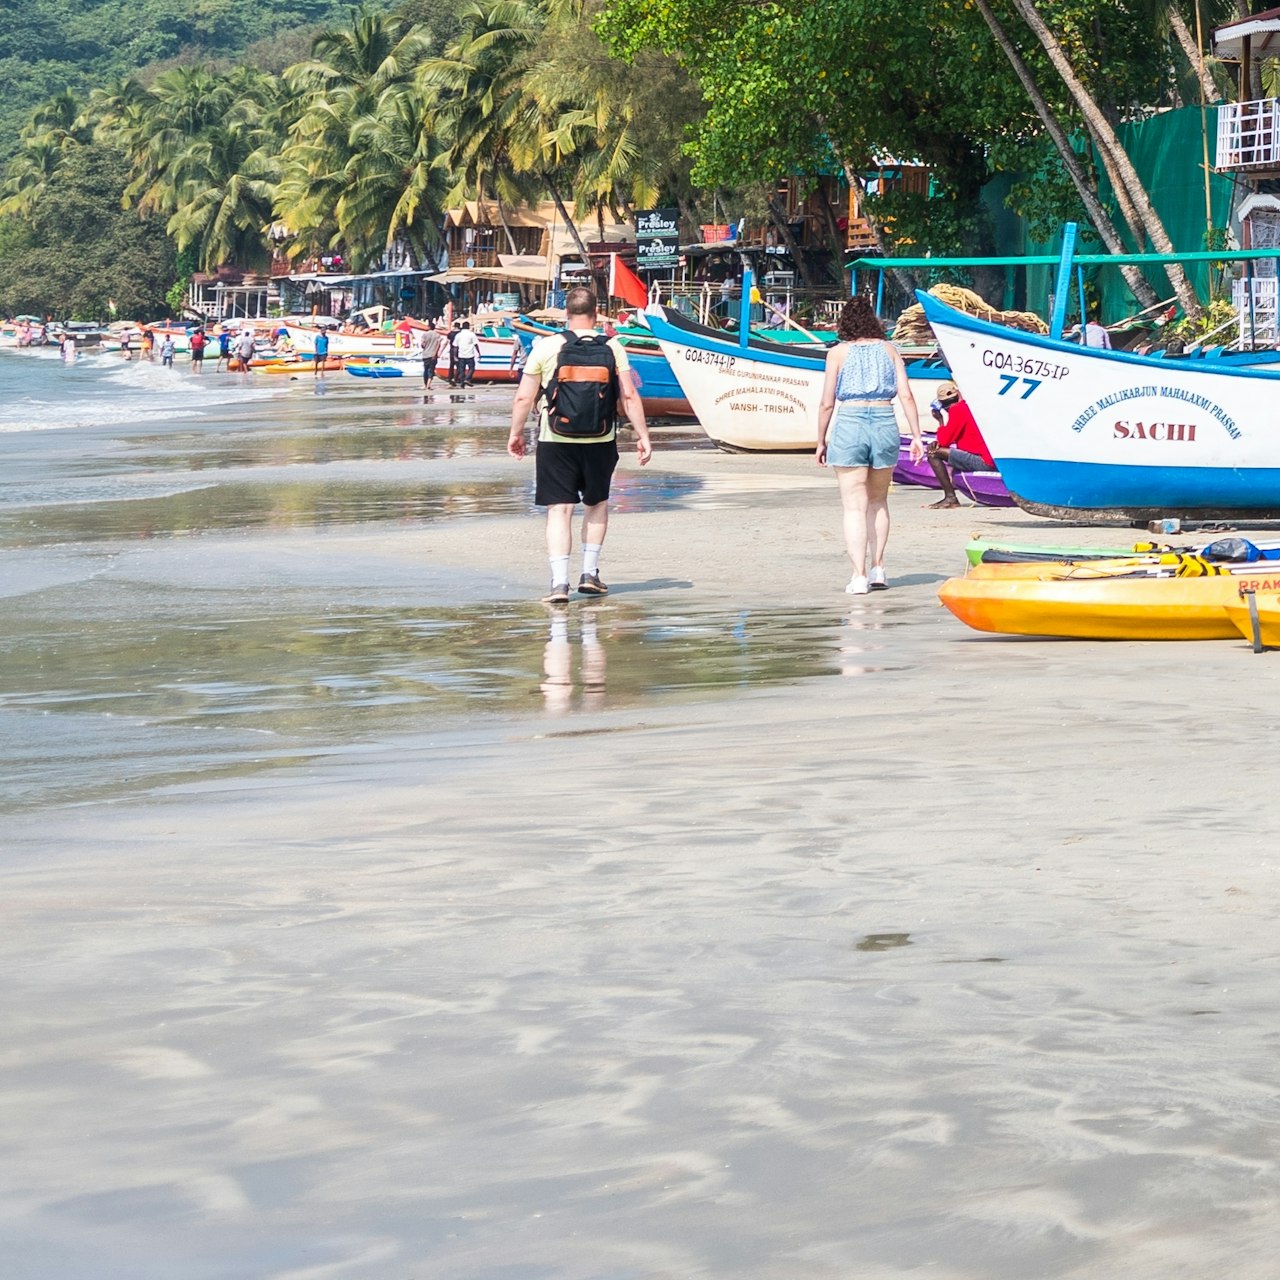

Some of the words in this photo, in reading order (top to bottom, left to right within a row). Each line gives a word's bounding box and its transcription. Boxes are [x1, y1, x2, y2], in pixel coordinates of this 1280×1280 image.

[638, 220, 676, 229] Presley
[639, 244, 676, 254] Presley
[718, 368, 736, 377] SHREE
[782, 377, 810, 387] PRASANN
[998, 374, 1042, 400] 77
[714, 389, 735, 406] SHREE
[736, 386, 776, 396] MAHALAXMI
[776, 390, 807, 412] PRASANN
[730, 402, 758, 412] VANSH
[764, 404, 795, 414] TRISHA
[1072, 405, 1098, 433] SHREE
[1096, 386, 1158, 411] MALLIKARJUN
[1160, 386, 1213, 411] MAHALAXMI
[1210, 405, 1242, 440] PRASSAN
[1113, 420, 1198, 442] SACHI
